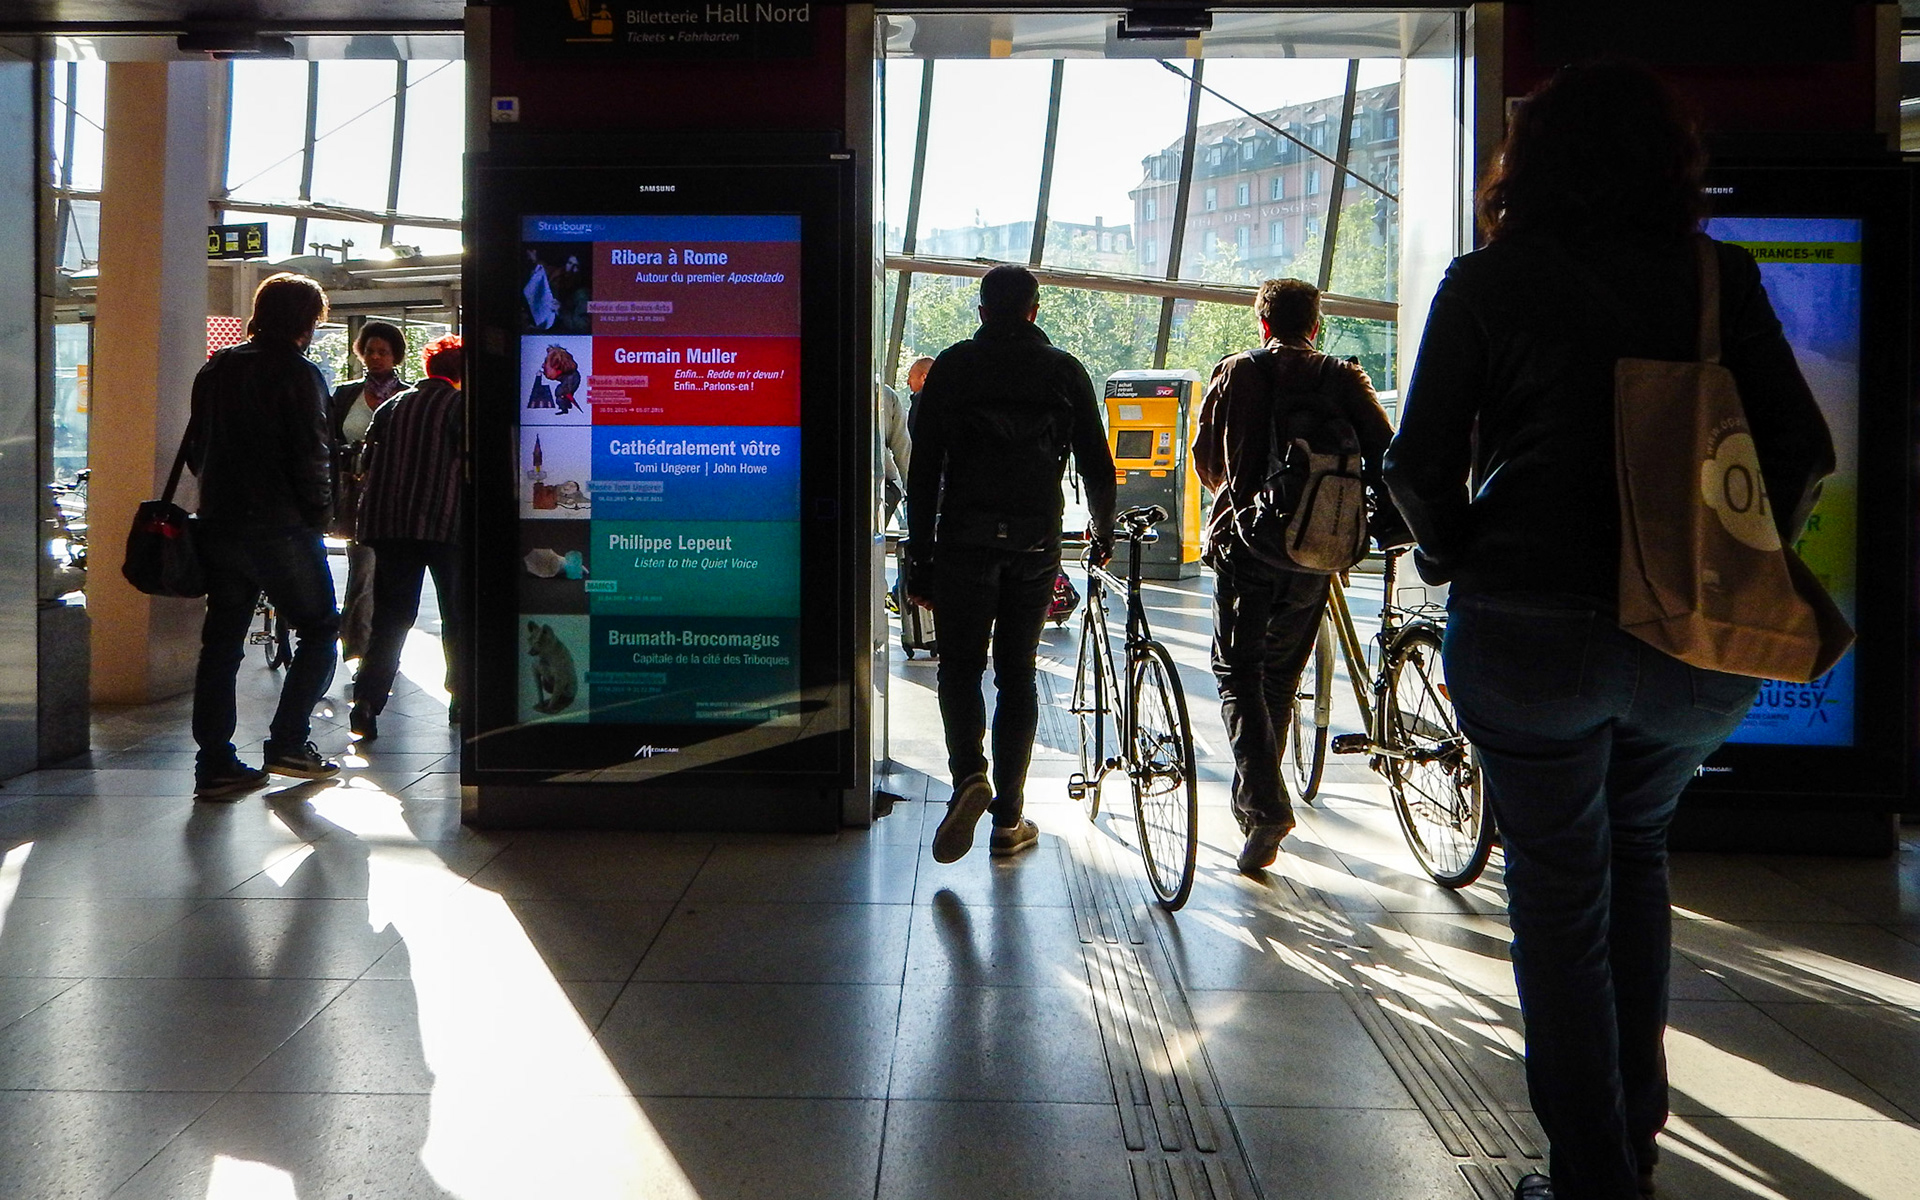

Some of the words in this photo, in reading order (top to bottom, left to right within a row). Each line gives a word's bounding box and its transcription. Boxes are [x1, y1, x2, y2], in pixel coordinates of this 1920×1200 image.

[626, 10, 699, 24] Billetterie
[705, 3, 749, 23] Hall
[755, 3, 810, 23] Nord
[627, 32, 666, 43] Tickets
[677, 31, 740, 43] Fahrkarten
[639, 185, 676, 193] SAMSUNG
[1260, 201, 1320, 218] VOSGES
[611, 249, 663, 265] Ribera
[667, 248, 678, 265] à
[683, 249, 728, 265] Rome
[1746, 247, 1835, 260] URANCES-VIE
[635, 272, 668, 283] Autour
[671, 272, 684, 283] du
[686, 272, 726, 284] premier
[727, 272, 785, 284] Apostolado
[614, 348, 681, 364] Germain
[686, 348, 738, 364] Muller
[674, 369, 704, 379] Enfin...
[707, 370, 735, 379] Redde
[752, 370, 778, 379] devun
[609, 439, 736, 456] Cathédralement
[741, 440, 781, 456] vôtre
[634, 462, 658, 473] Tomi
[660, 462, 701, 476] Ungerer
[712, 462, 737, 474] John
[739, 462, 768, 474] Howe
[609, 534, 672, 553] Philippe
[678, 535, 732, 553] Lepeut
[634, 557, 665, 568] Listen
[668, 558, 679, 568] to
[681, 557, 698, 568] the
[700, 557, 728, 570] Quiet
[731, 558, 758, 569] Voice
[608, 630, 780, 650] Brumath-Brocomagus
[633, 653, 673, 665] Capitale
[676, 654, 688, 664] de
[691, 654, 700, 664] la
[702, 654, 721, 664] cité
[723, 654, 741, 664] des
[743, 654, 790, 667] Triboques
